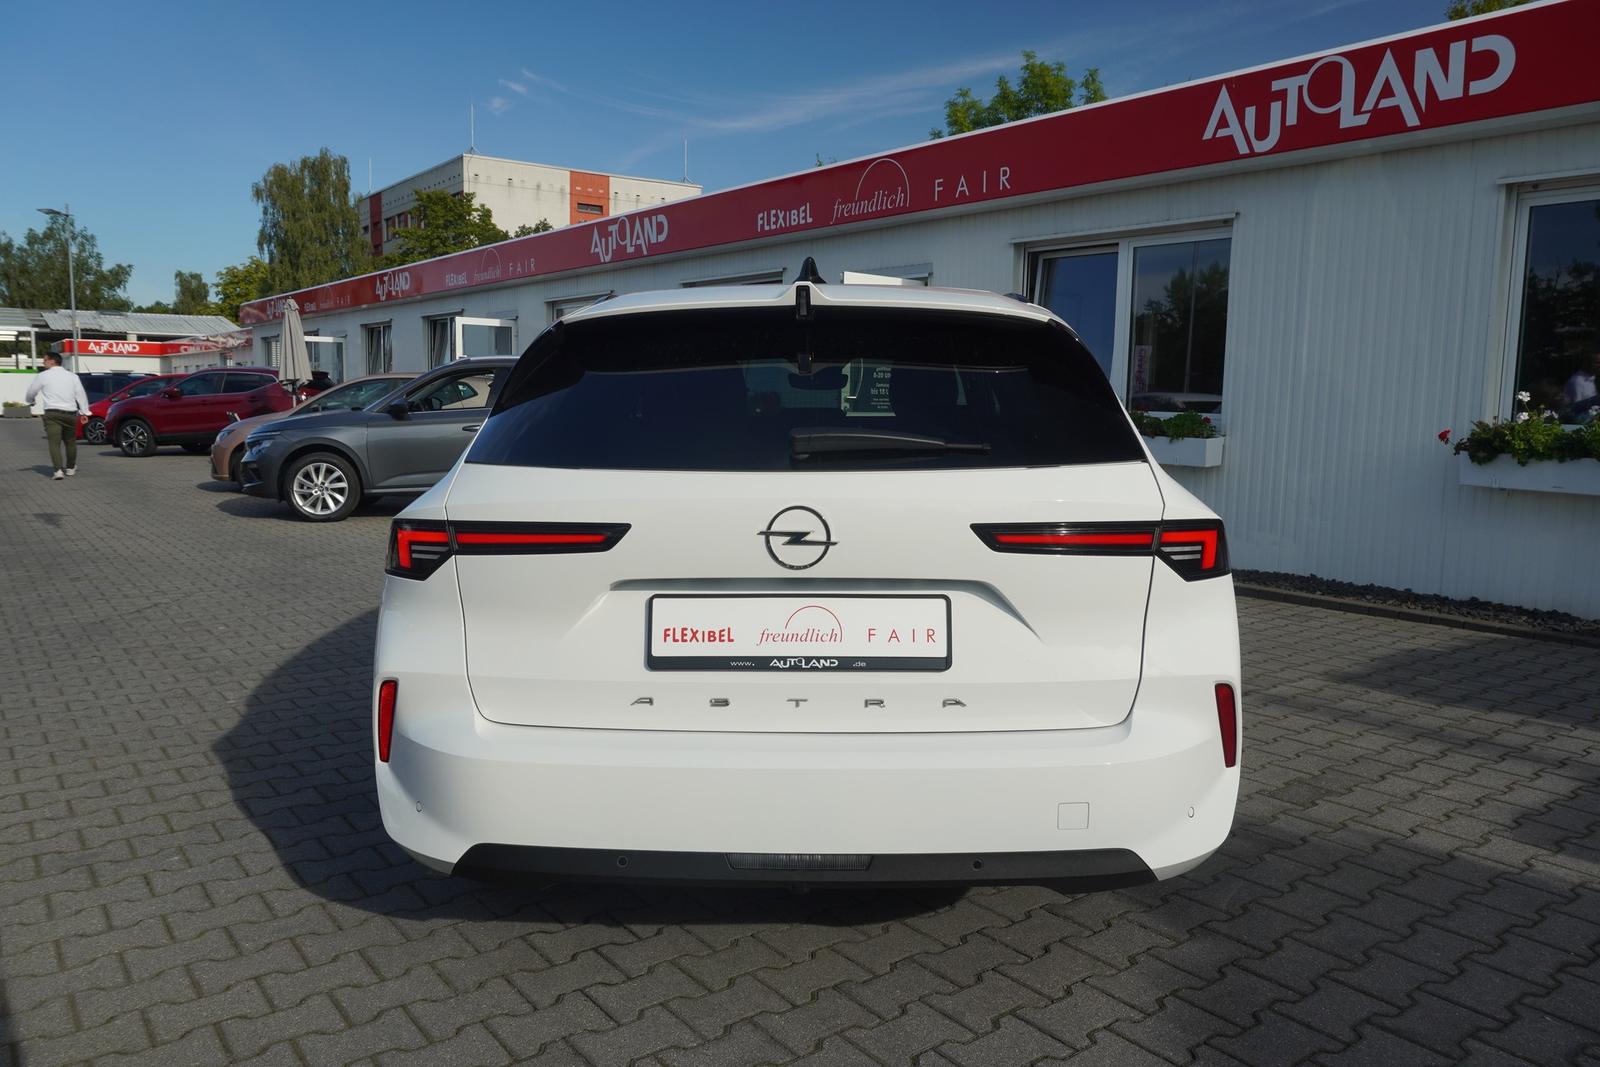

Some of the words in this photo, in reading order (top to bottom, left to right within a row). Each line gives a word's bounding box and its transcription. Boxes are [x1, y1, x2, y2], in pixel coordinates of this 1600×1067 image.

[1202, 34, 1517, 155] AUTOLAND
[757, 202, 813, 232] FLEXIBEL
[830, 186, 906, 225] freundlich
[934, 166, 1011, 201] FAIR
[590, 215, 668, 262] AUTOLAND
[509, 261, 536, 276] FAIR
[375, 272, 410, 301] AUTOLAND
[88, 341, 140, 354] AUTOLAND
[663, 627, 734, 643] FLEXIBEL
[756, 628, 838, 646] freundlich
[868, 628, 936, 643] FAIR
[769, 657, 839, 669] AUTOLAND
[852, 660, 867, 668] .de
[630, 697, 967, 708] ASTRA
